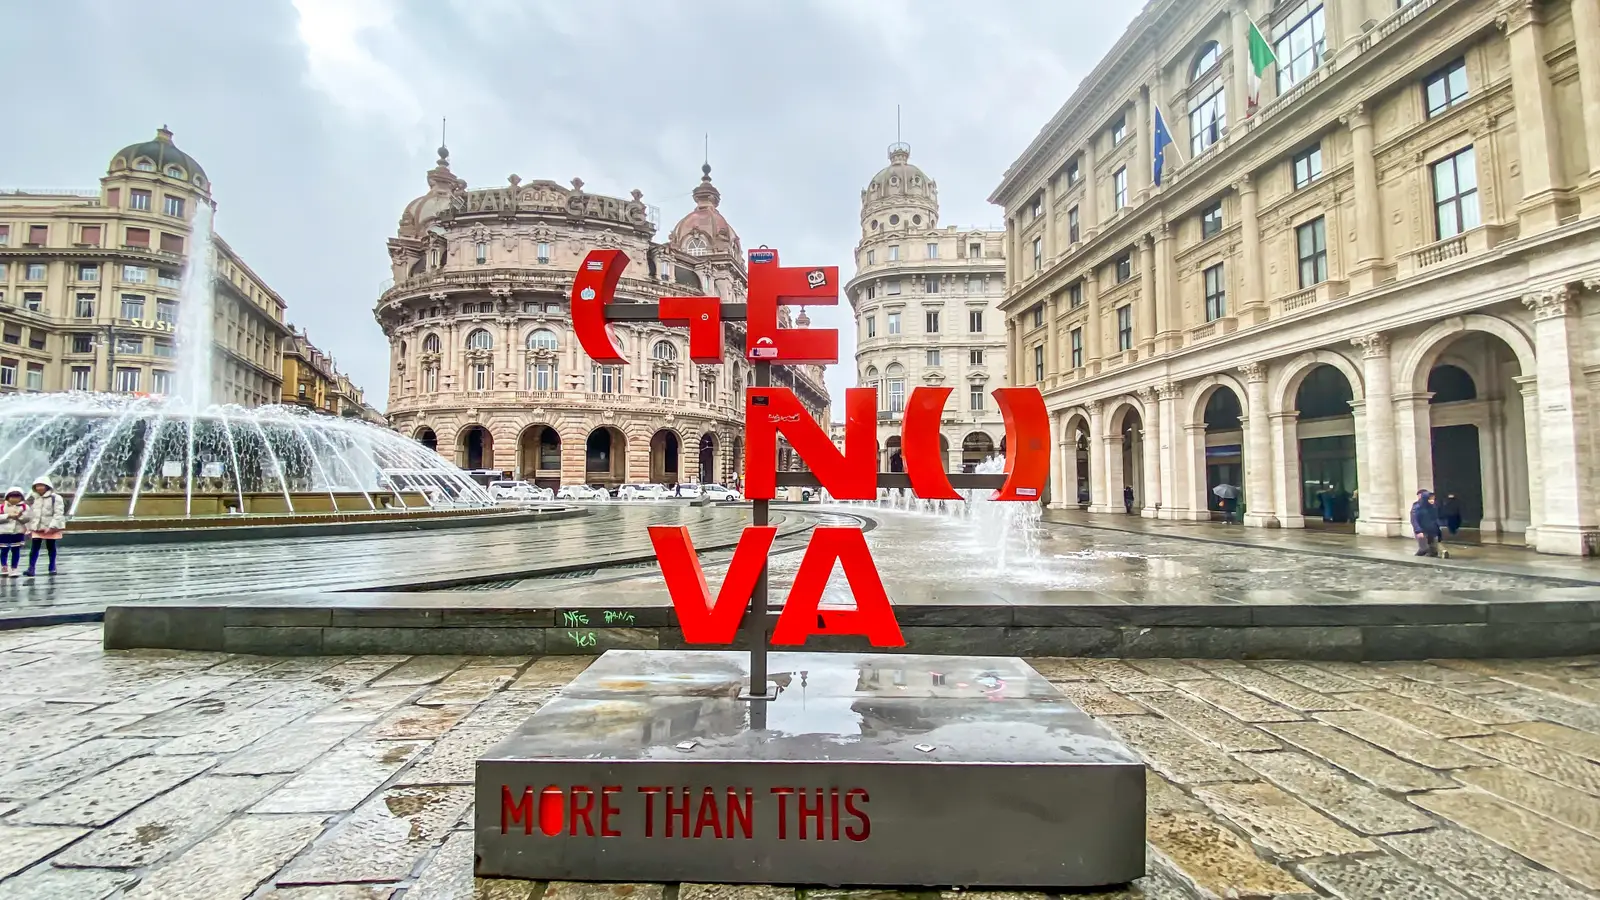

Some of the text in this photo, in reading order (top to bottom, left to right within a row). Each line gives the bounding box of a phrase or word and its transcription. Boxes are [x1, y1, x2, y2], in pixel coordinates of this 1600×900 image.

[501, 784, 871, 843] MORE THAN THIS
